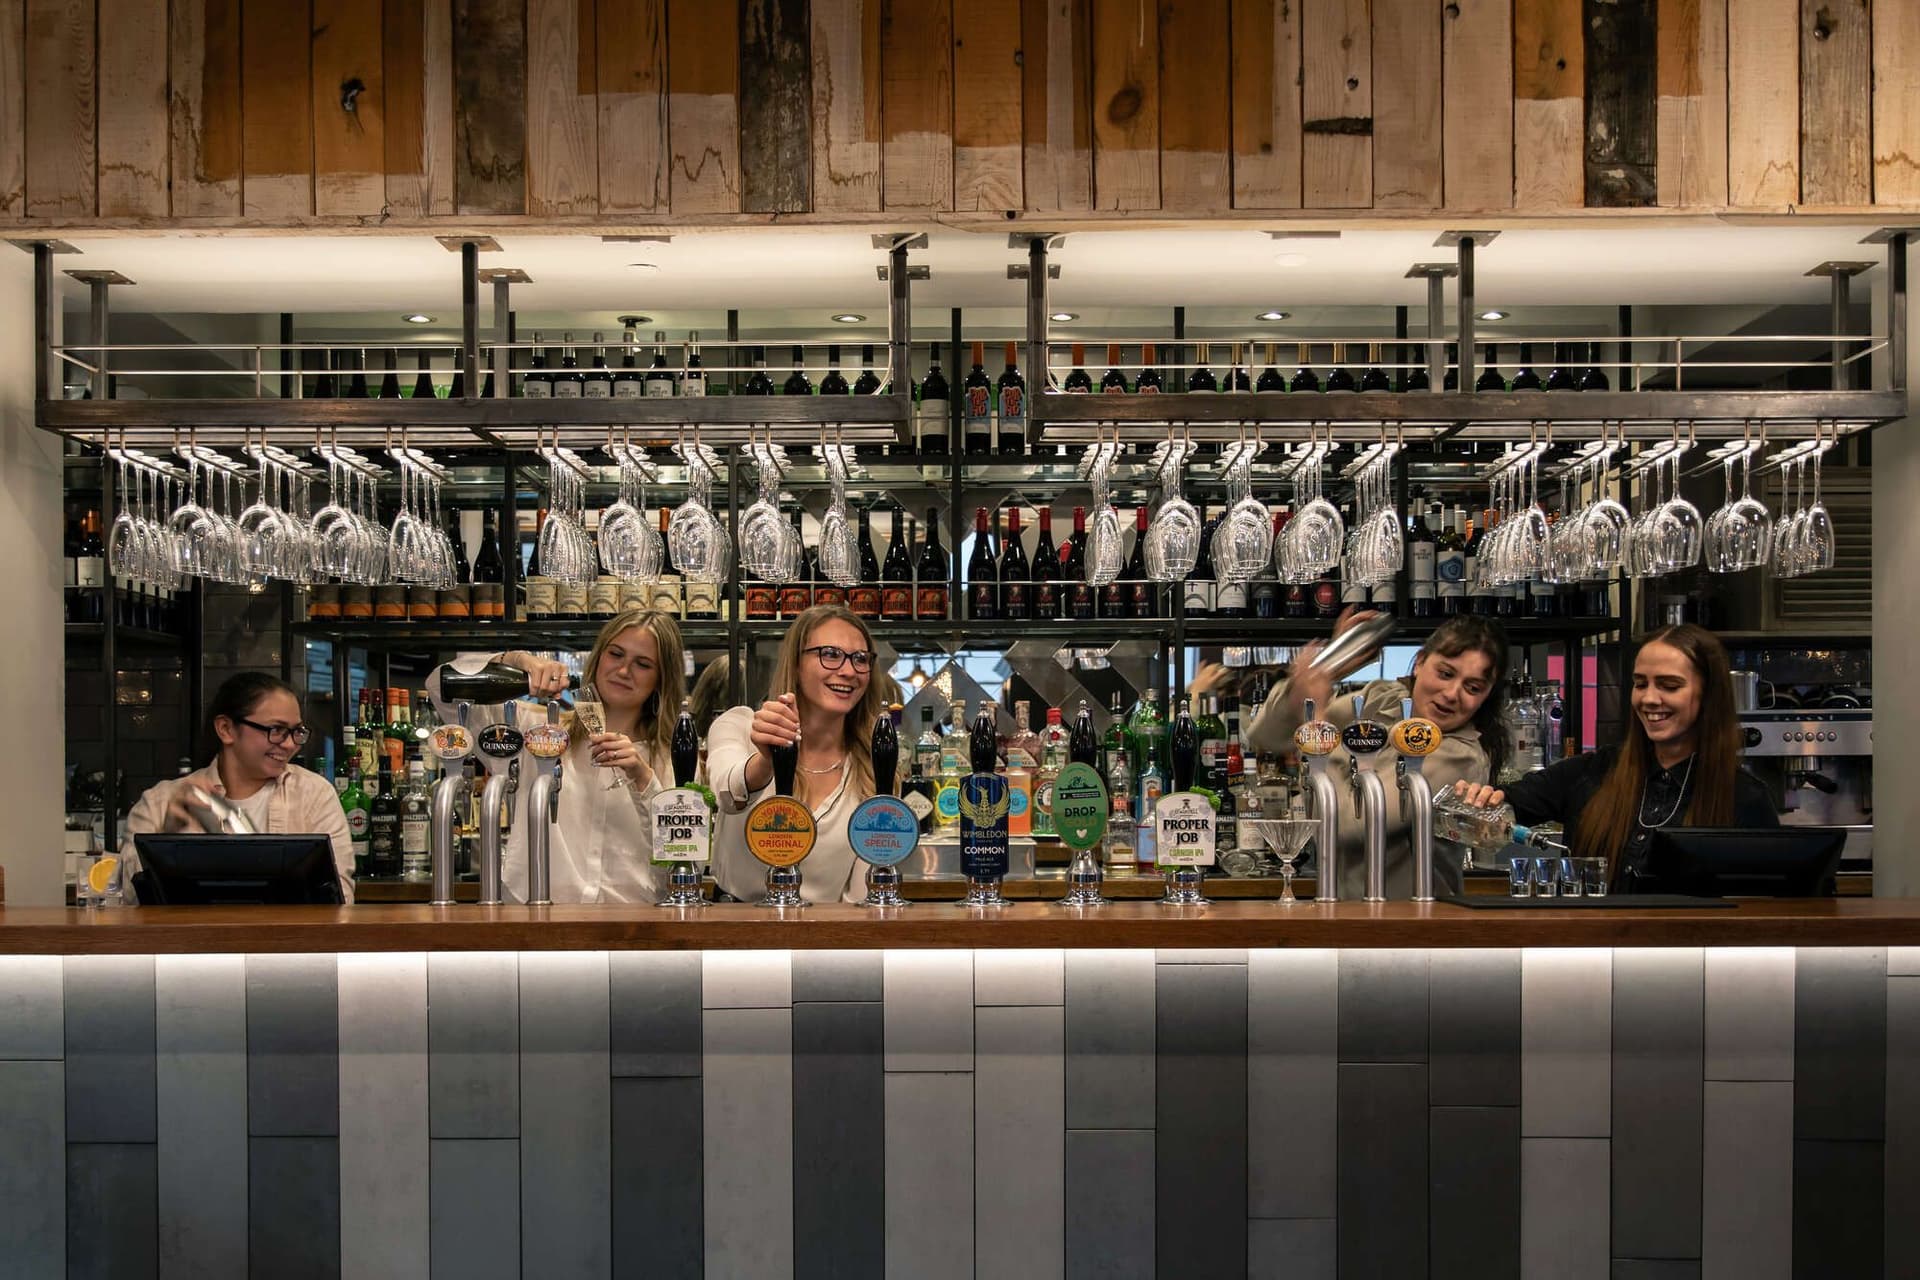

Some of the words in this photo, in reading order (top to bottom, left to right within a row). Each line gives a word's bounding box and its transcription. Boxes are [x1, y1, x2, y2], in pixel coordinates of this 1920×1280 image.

[1299, 731, 1321, 744] NECK
[1323, 731, 1336, 744] OIL
[1347, 737, 1382, 746] GUINNESS
[482, 741, 517, 751] GUINNESS
[1064, 806, 1097, 818] DROP
[658, 814, 704, 826] PROPER
[1064, 817, 1097, 827] GOLD
[1163, 818, 1210, 830] PROPER
[670, 828, 693, 841] JOB
[962, 830, 1008, 839] WIMBLEDON
[1176, 832, 1199, 845] JOB
[688, 844, 698, 852] IPA
[758, 839, 804, 848] ORIGINAL
[863, 839, 902, 849] SPECIAL
[964, 846, 1005, 855] COMMON
[1194, 848, 1204, 856] IPA
